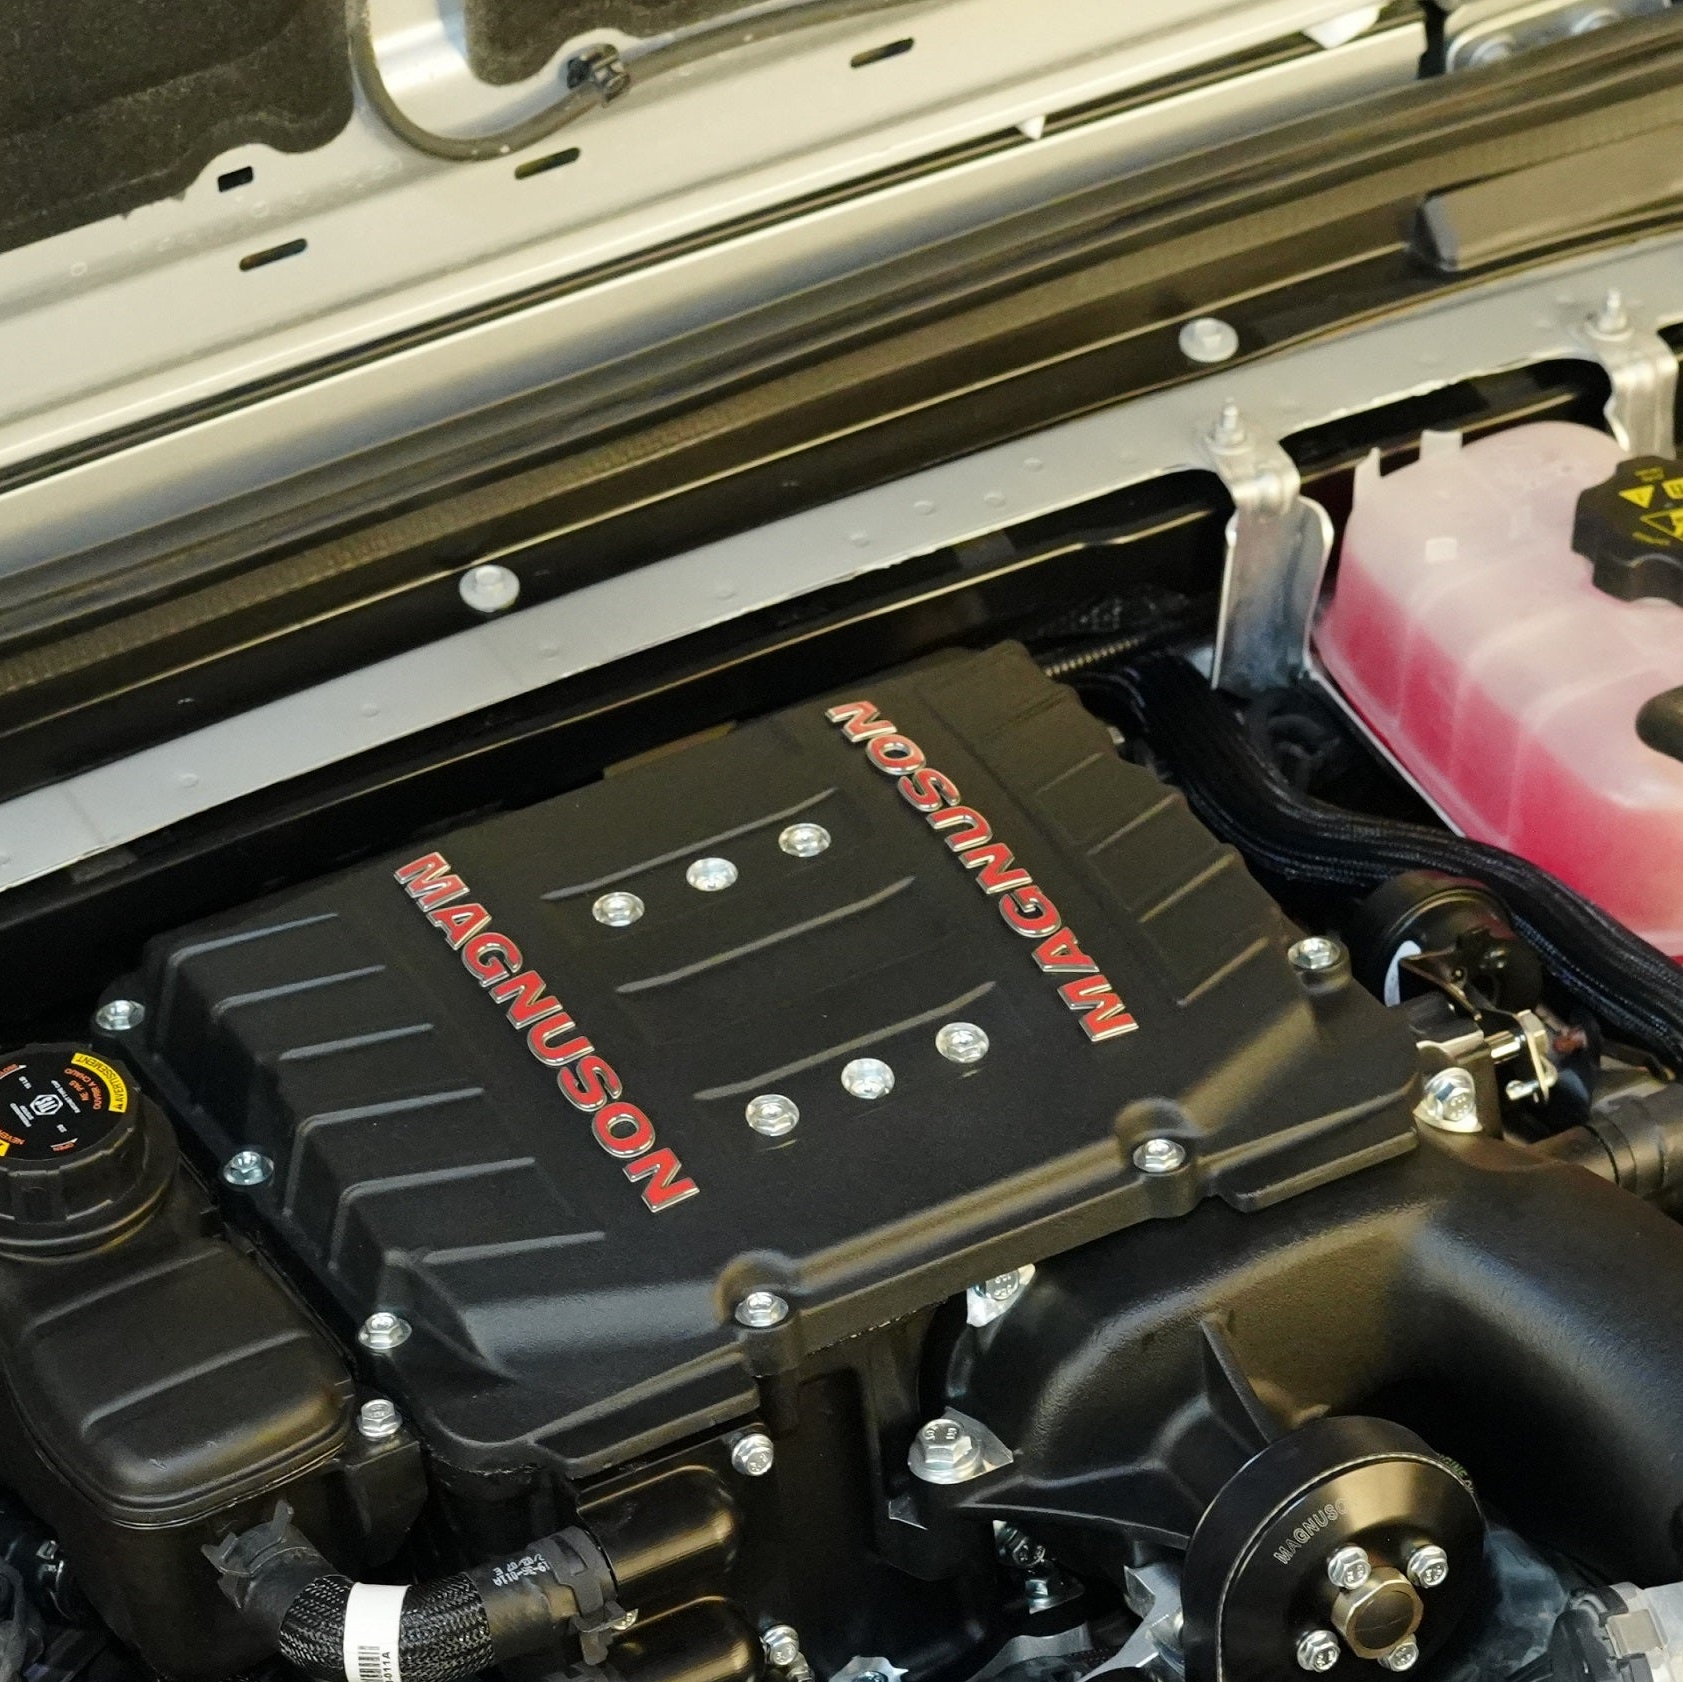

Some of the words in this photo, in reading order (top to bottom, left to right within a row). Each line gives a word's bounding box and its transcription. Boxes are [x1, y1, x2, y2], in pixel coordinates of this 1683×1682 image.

[824, 699, 1139, 1043] MAGNUSON
[76, 1055, 124, 1102] AVERTISSEMENT
[393, 851, 700, 1212] MAGNUSON
[1273, 1497, 1350, 1565] MAGNUSO
